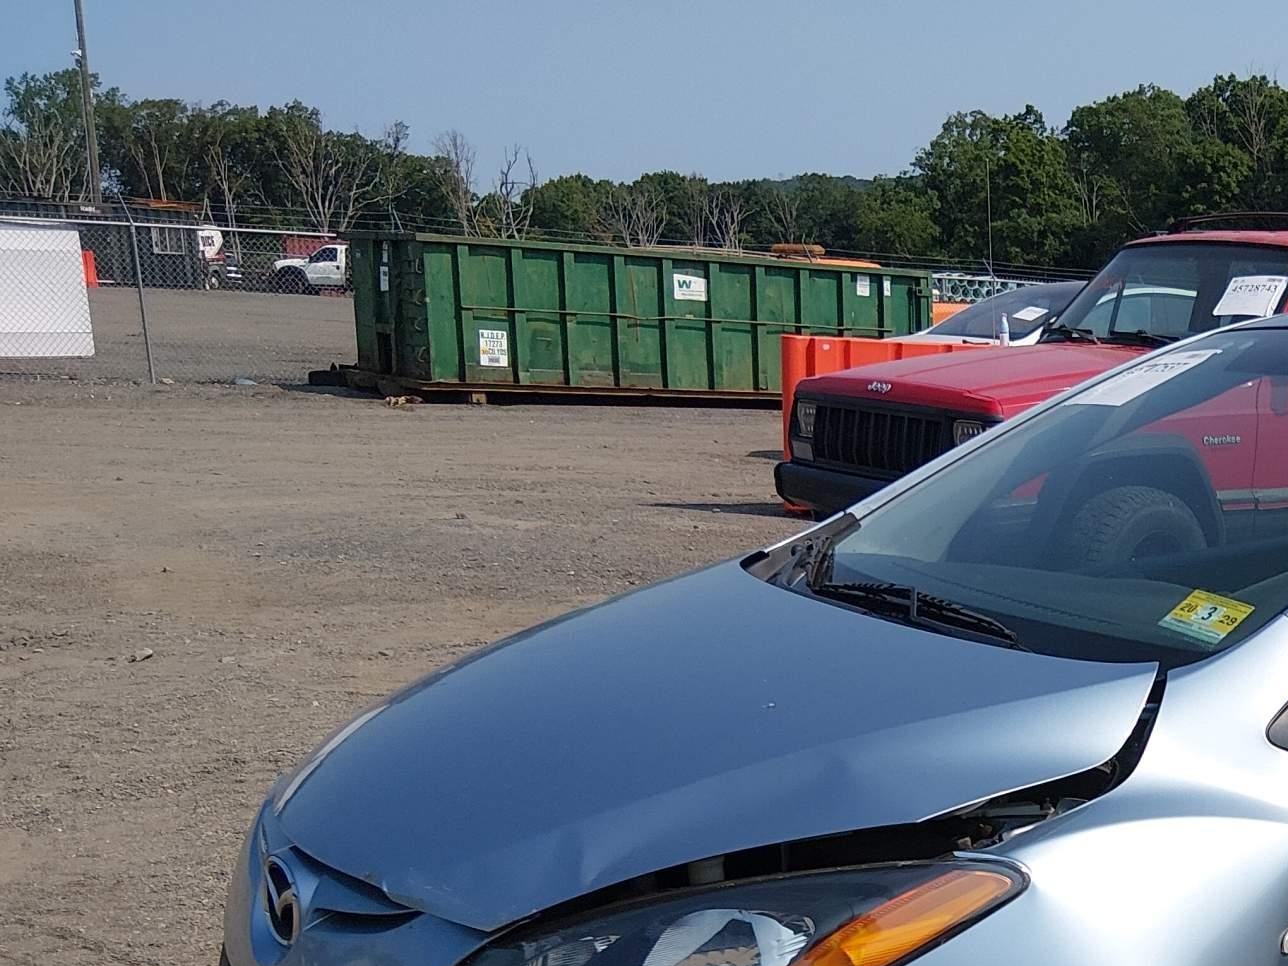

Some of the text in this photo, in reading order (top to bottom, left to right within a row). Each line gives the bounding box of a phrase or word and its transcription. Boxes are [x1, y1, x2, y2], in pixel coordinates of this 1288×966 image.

[1202, 435, 1241, 446] Cherokee
[1180, 602, 1238, 627] 20 3 29
